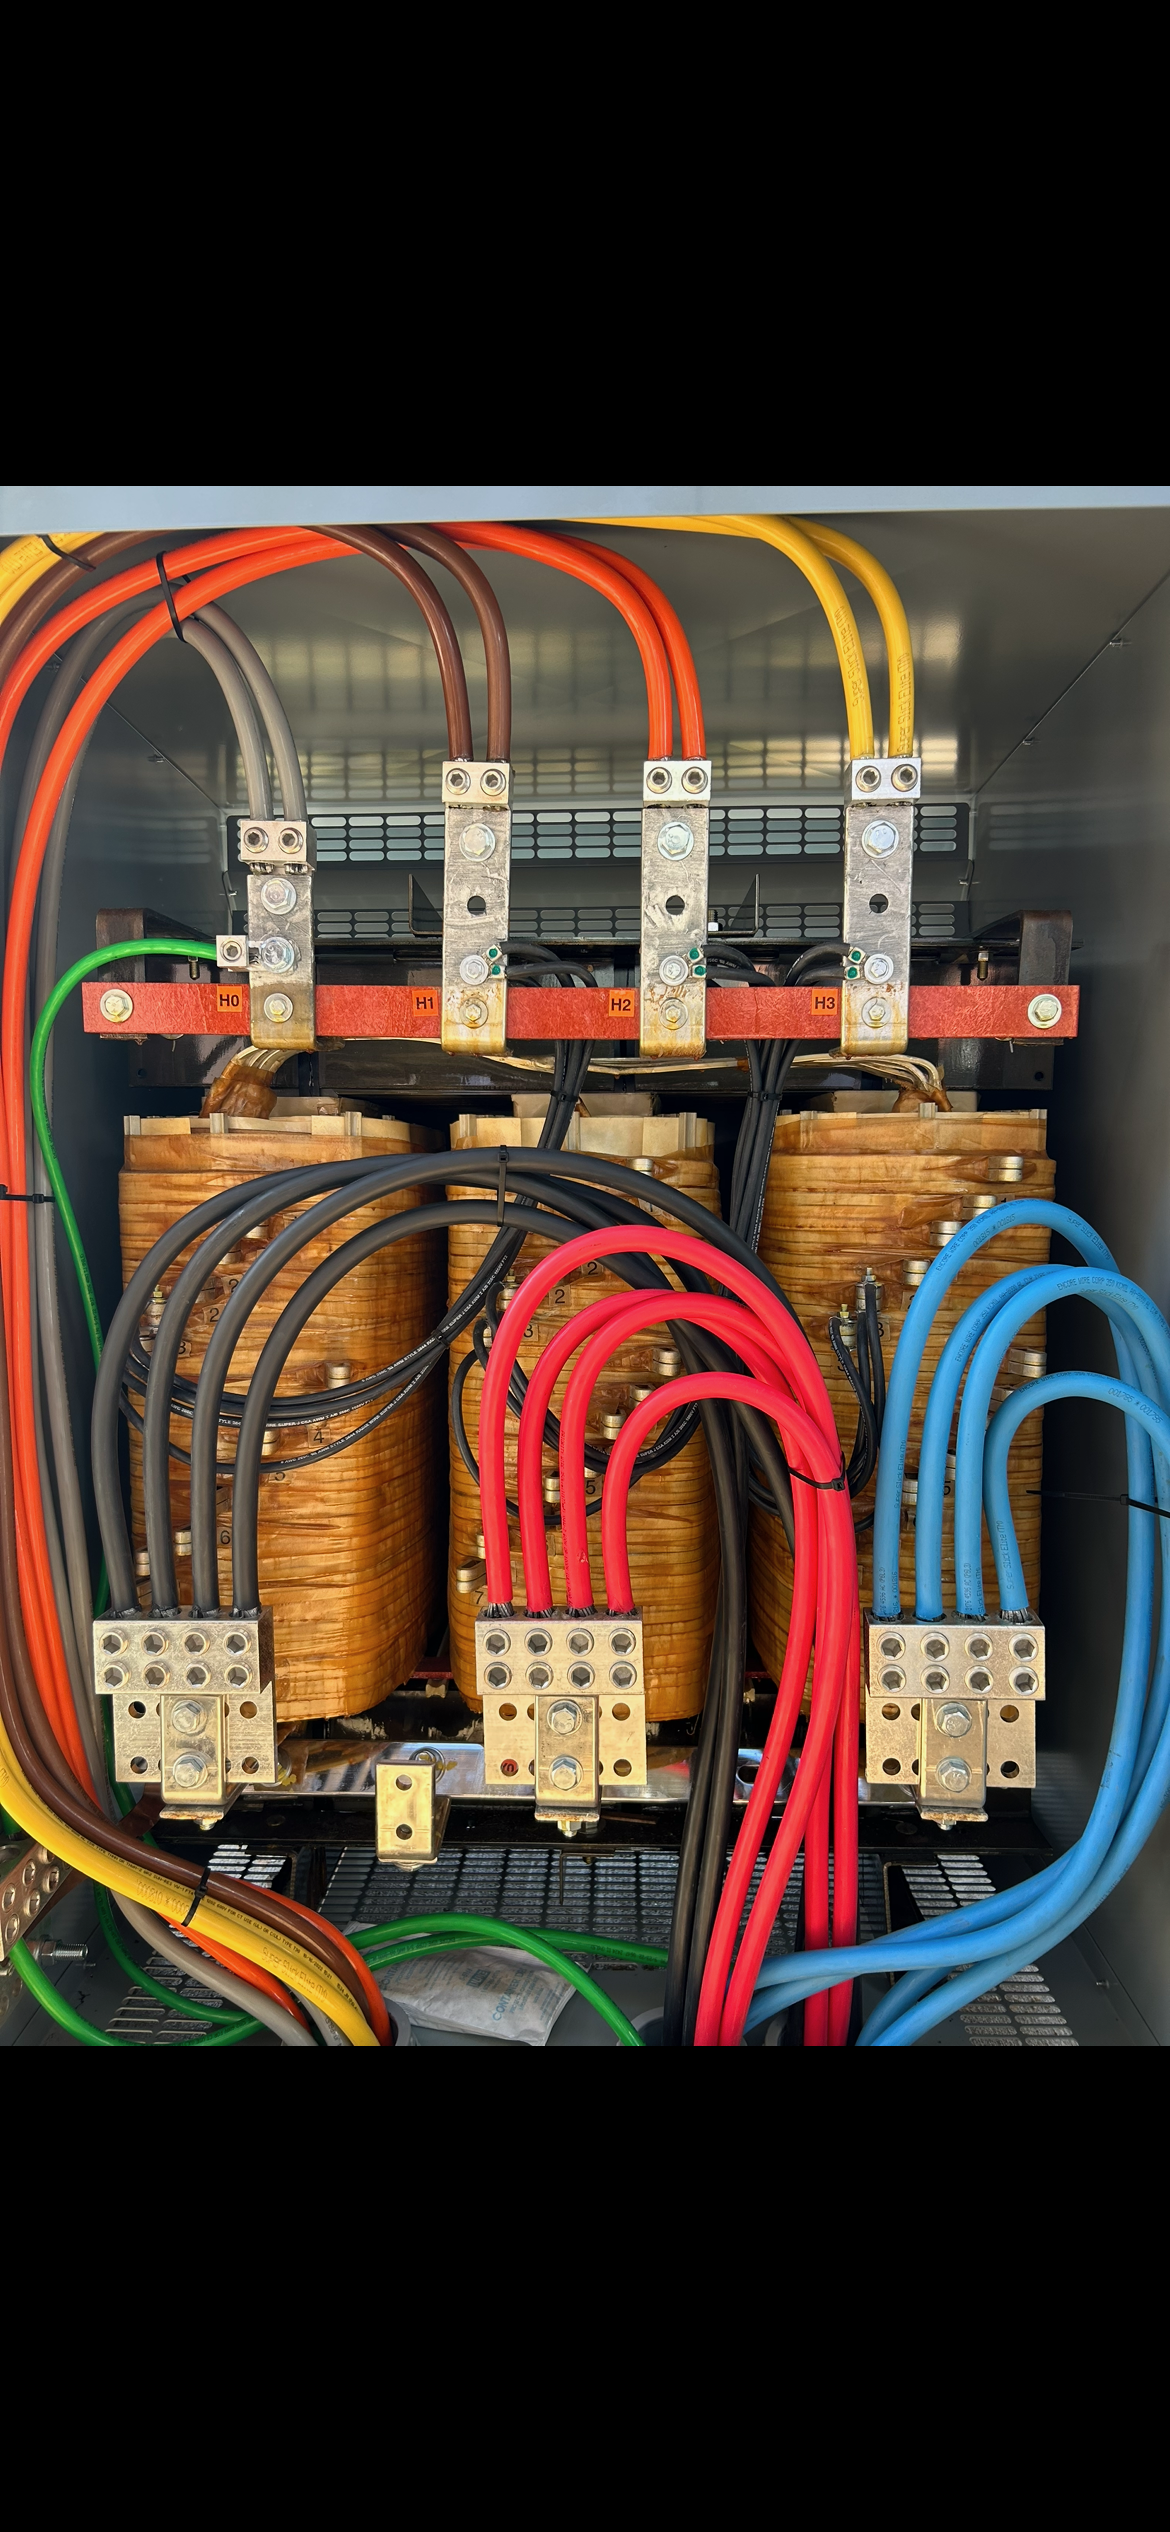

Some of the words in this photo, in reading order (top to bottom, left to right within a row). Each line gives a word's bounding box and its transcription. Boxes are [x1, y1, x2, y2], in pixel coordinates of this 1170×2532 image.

[837, 623, 856, 654] Elite
[843, 653, 861, 678] Slick
[897, 671, 911, 699] Elite
[897, 697, 910, 724] Slick
[220, 994, 240, 1007] H0
[416, 997, 434, 1010] H1
[611, 998, 631, 1011] H2
[815, 997, 835, 1010] H3
[949, 1241, 960, 1253] WIRE
[1090, 1235, 1105, 1250] Elite
[587, 1262, 598, 1275] 2
[229, 1279, 238, 1292] 2
[1056, 1278, 1077, 1290] ENCORE
[554, 1289, 566, 1304] 2
[210, 1308, 218, 1322] 2
[524, 1324, 534, 1338] 3
[403, 1350, 417, 1361] STYLE
[313, 1431, 324, 1444] 4
[329, 1438, 345, 1448] STYLE
[586, 1480, 596, 1494] 5
[220, 1530, 231, 1544] 6
[998, 1533, 1008, 1551] Elite
[1001, 1552, 1011, 1569] Slick
[475, 1590, 484, 1604] 7
[492, 1979, 520, 2021] CONTAINER
